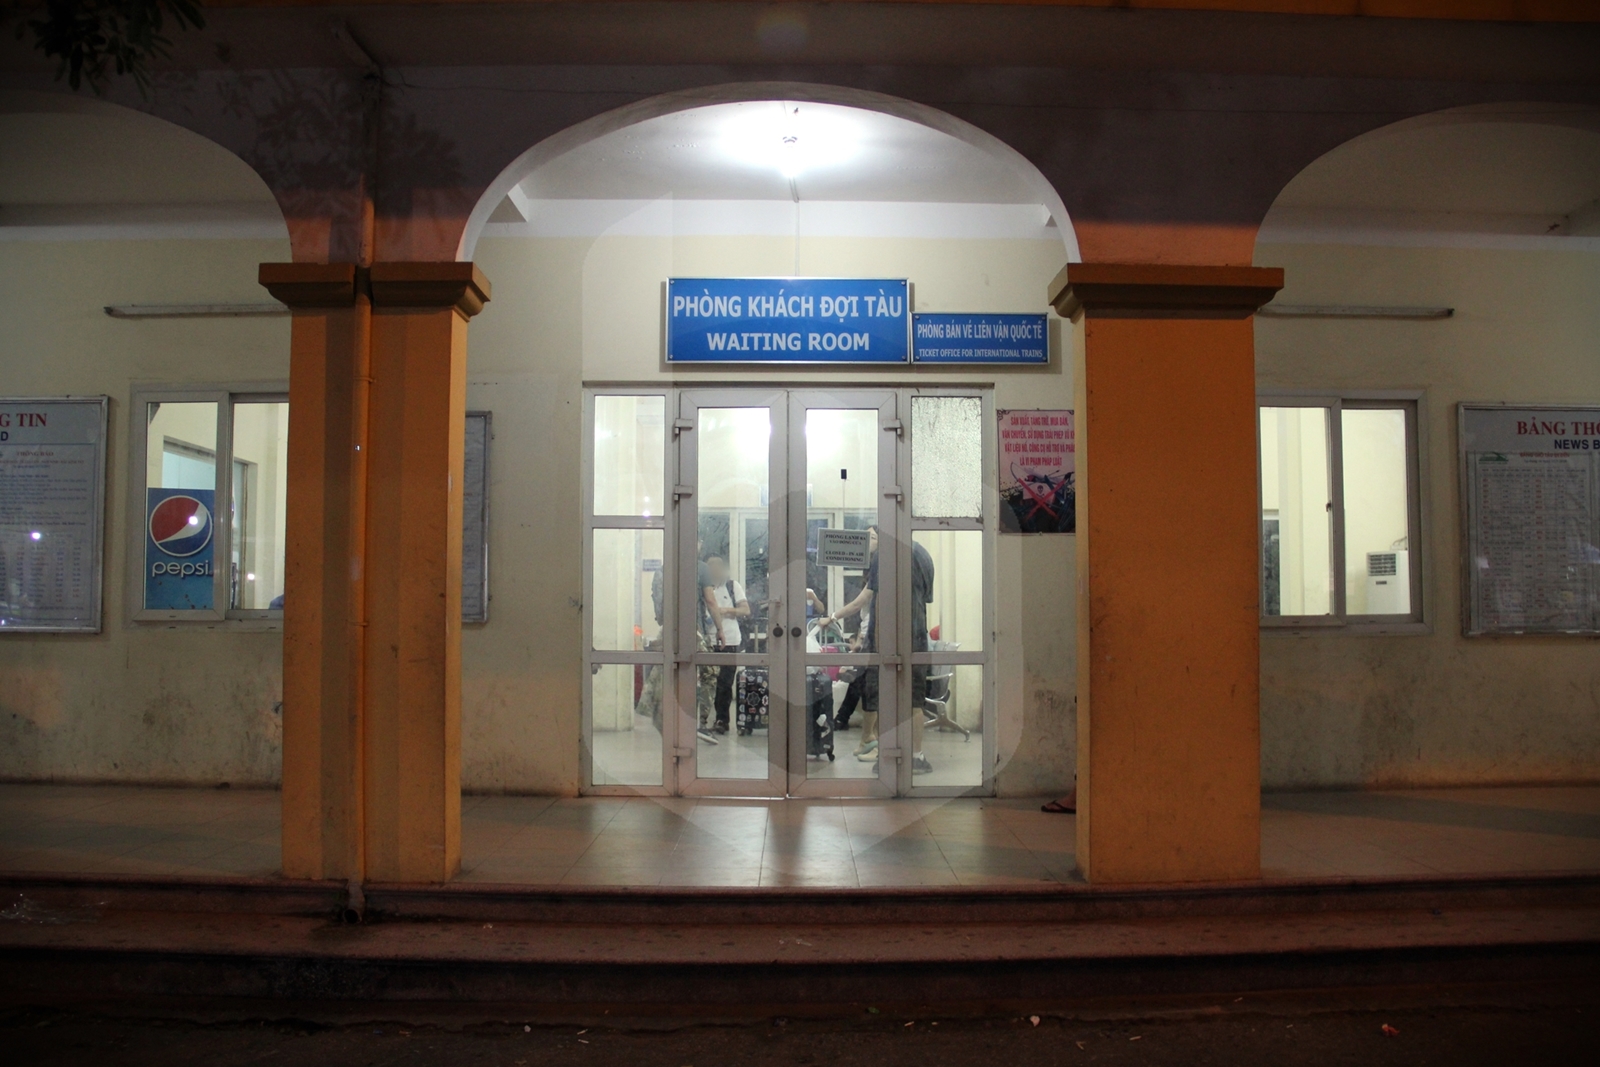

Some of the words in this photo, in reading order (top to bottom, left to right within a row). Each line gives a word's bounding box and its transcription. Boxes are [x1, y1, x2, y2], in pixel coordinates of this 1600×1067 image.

[674, 289, 742, 317] PHÒNG
[748, 289, 814, 317] KHÁCH
[820, 296, 859, 322] ĐỢI
[864, 289, 902, 317] TÀU
[918, 320, 944, 338] PHÒNG
[946, 320, 960, 338] BÁN
[963, 320, 972, 338] VÉ
[974, 320, 991, 338] LIÊN
[995, 320, 1008, 342] VẬN
[1010, 320, 1031, 342] QUỐC
[1033, 320, 1042, 339] TẾ
[706, 332, 801, 351] WAITING
[808, 332, 869, 351] ROOM
[919, 349, 939, 357] TICKET
[940, 349, 960, 357] OFFICE
[974, 349, 1020, 357] INTERNATIONAL
[1022, 349, 1042, 357] TRAINS
[16, 413, 47, 427] TIN
[1517, 416, 1566, 435] BẢNG
[1, 432, 8, 441] D
[1554, 440, 1589, 450] NEWS
[152, 560, 208, 577] pepsi
